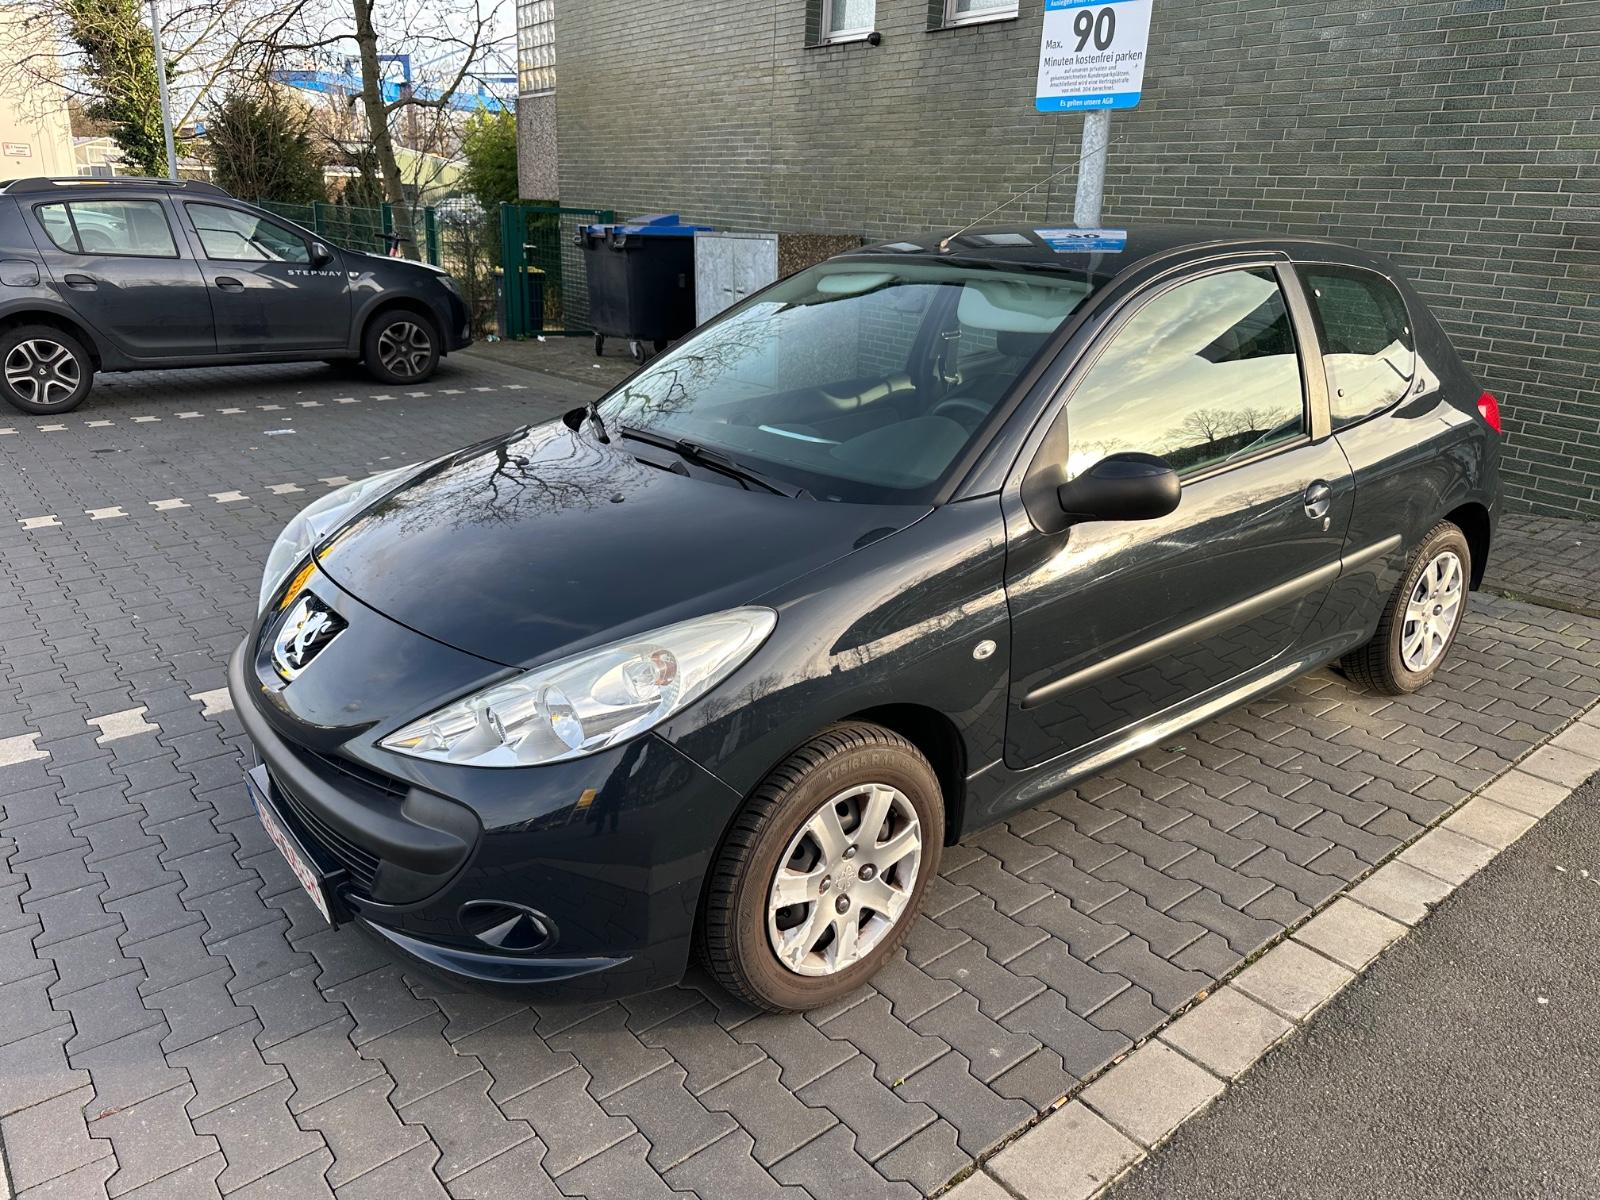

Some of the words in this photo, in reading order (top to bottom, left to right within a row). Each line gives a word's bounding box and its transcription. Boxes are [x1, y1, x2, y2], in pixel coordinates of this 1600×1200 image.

[1046, 40, 1063, 50] Max.
[1074, 7, 1115, 52] 90
[1044, 56, 1074, 67] Minuten
[1075, 51, 1114, 65] kostenfrei
[1115, 50, 1143, 64] parken
[1102, 97, 1114, 105] AGB
